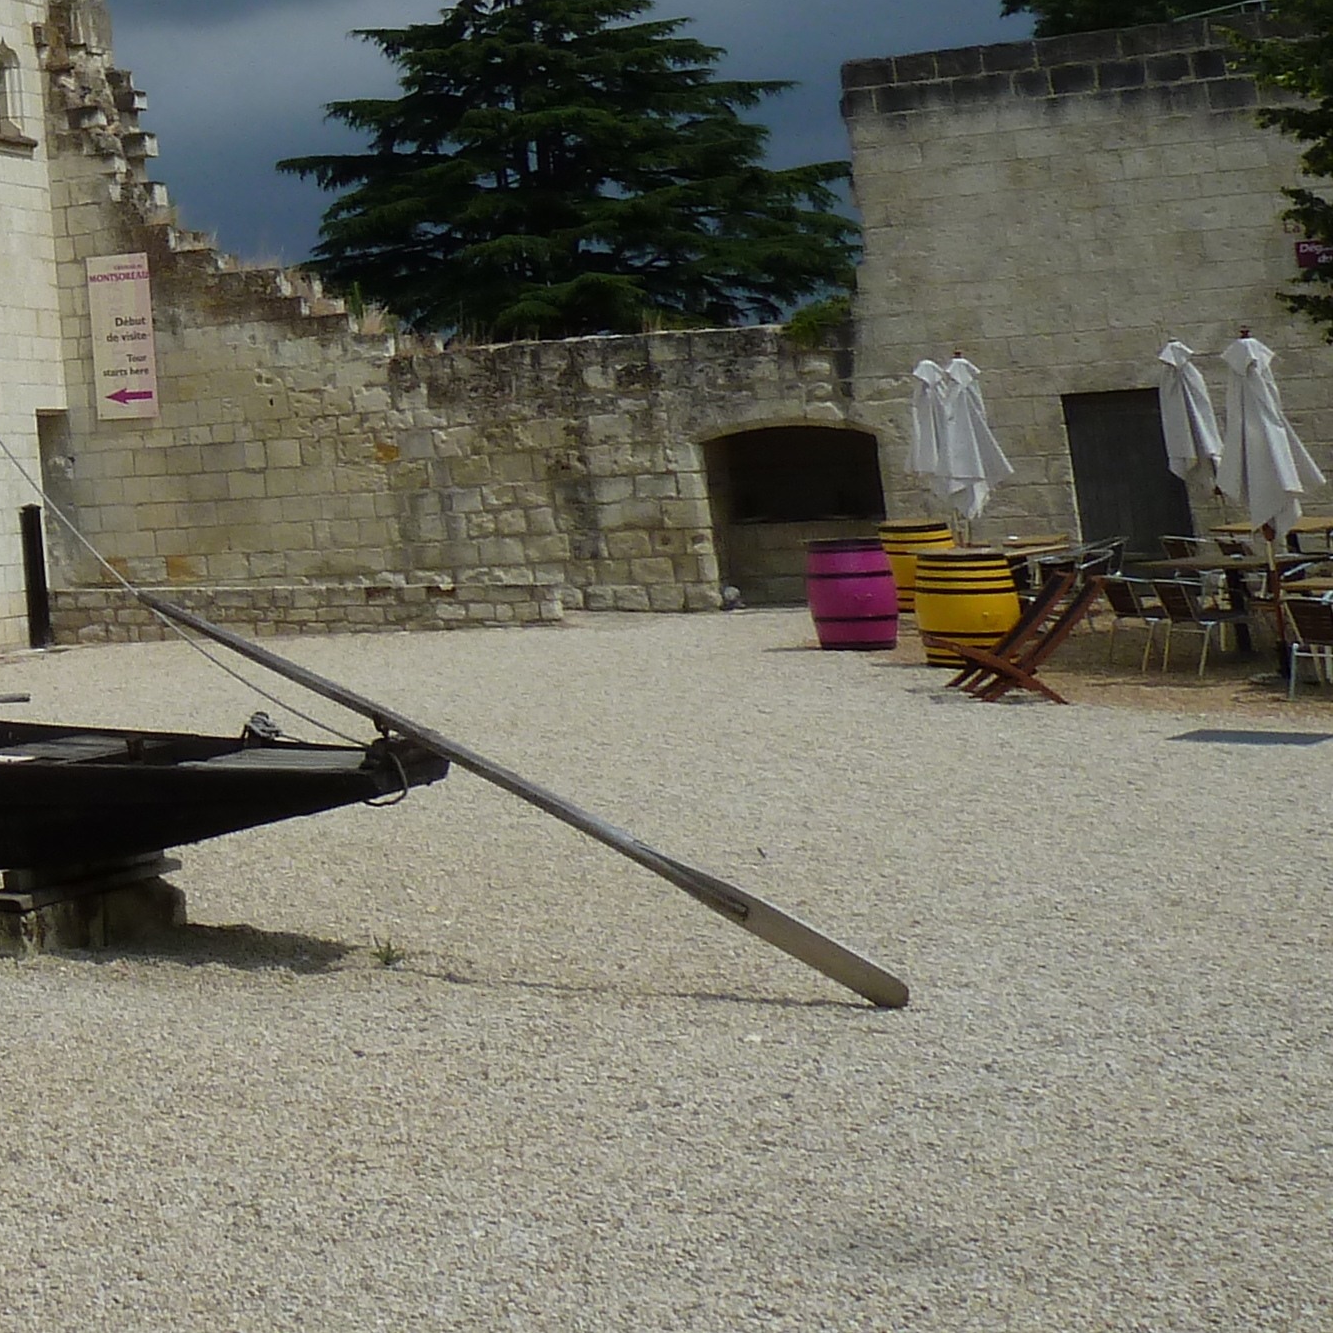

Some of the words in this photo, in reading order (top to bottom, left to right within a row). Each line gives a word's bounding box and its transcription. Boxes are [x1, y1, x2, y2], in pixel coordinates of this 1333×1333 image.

[115, 316, 146, 327] Début
[107, 333, 119, 342] de
[122, 331, 147, 341] visite
[126, 354, 147, 362] Tour
[103, 368, 128, 376] starts
[130, 367, 149, 375] here
